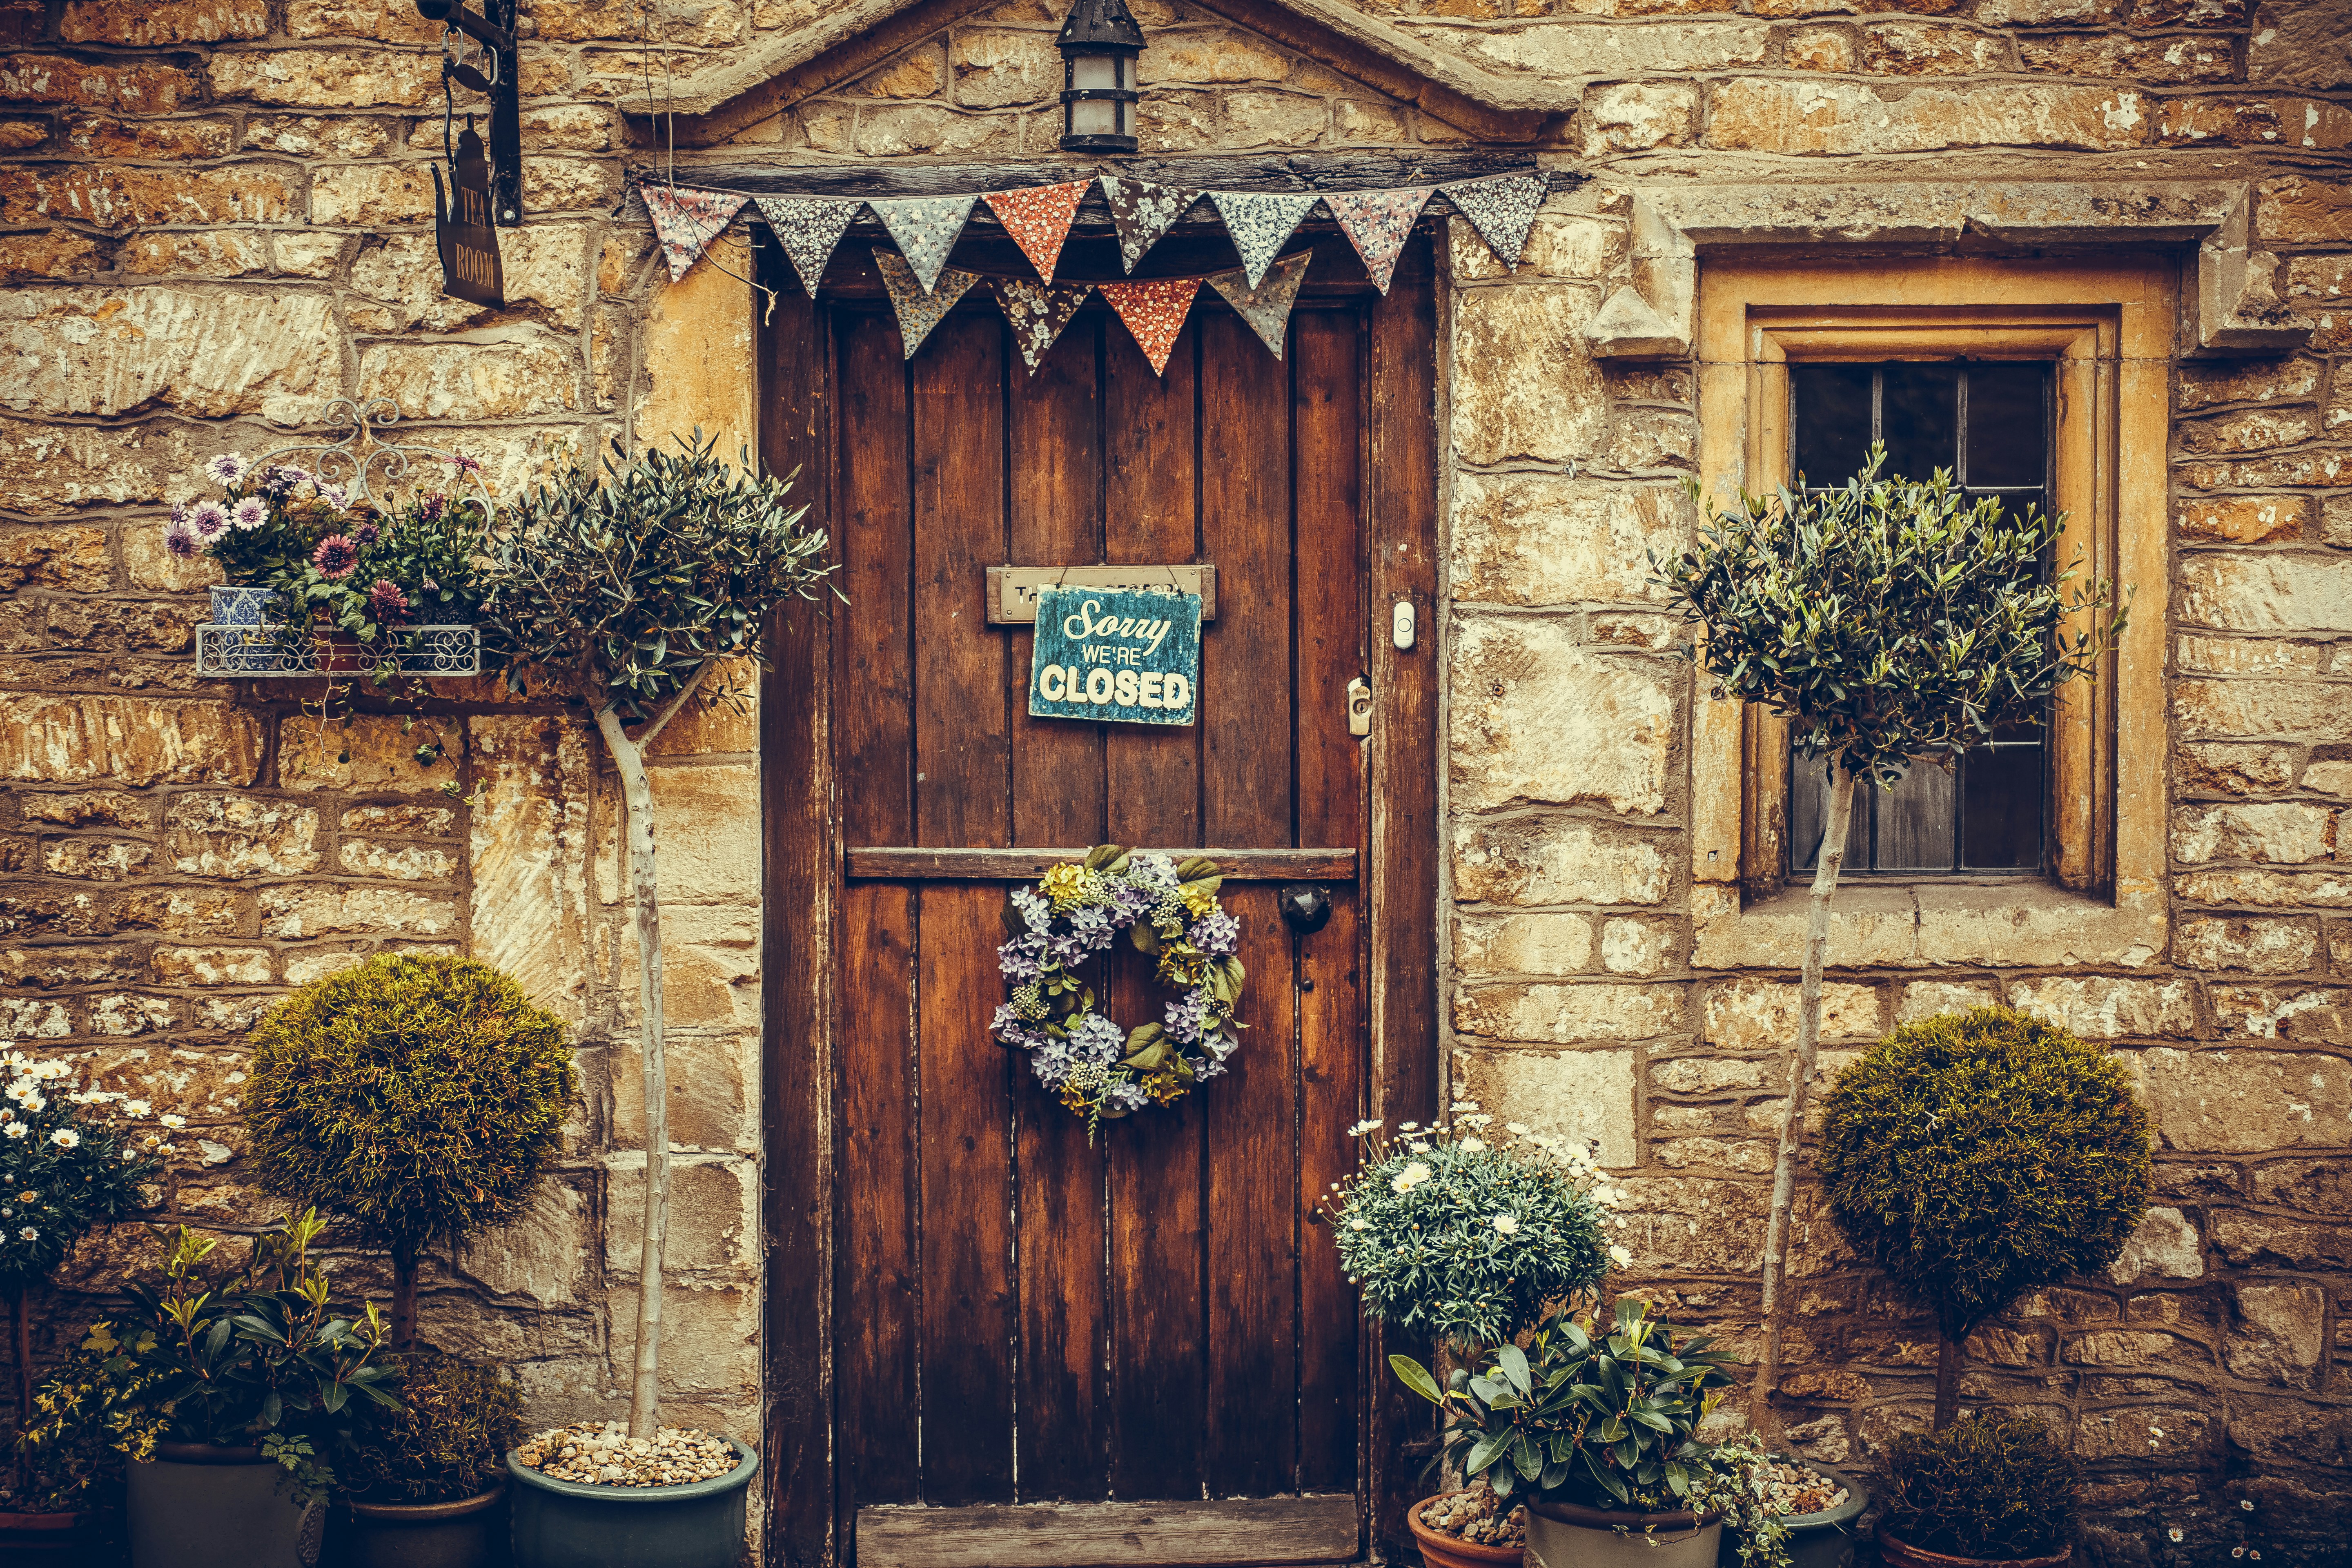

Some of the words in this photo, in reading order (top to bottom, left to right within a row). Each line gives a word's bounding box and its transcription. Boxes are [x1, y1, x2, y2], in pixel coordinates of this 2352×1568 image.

[461, 186, 487, 229] TEA
[455, 243, 494, 288] ROOM
[1063, 599, 1172, 657] Sorry
[1082, 644, 1141, 666] WE'RE
[1039, 664, 1190, 709] CLOSED
